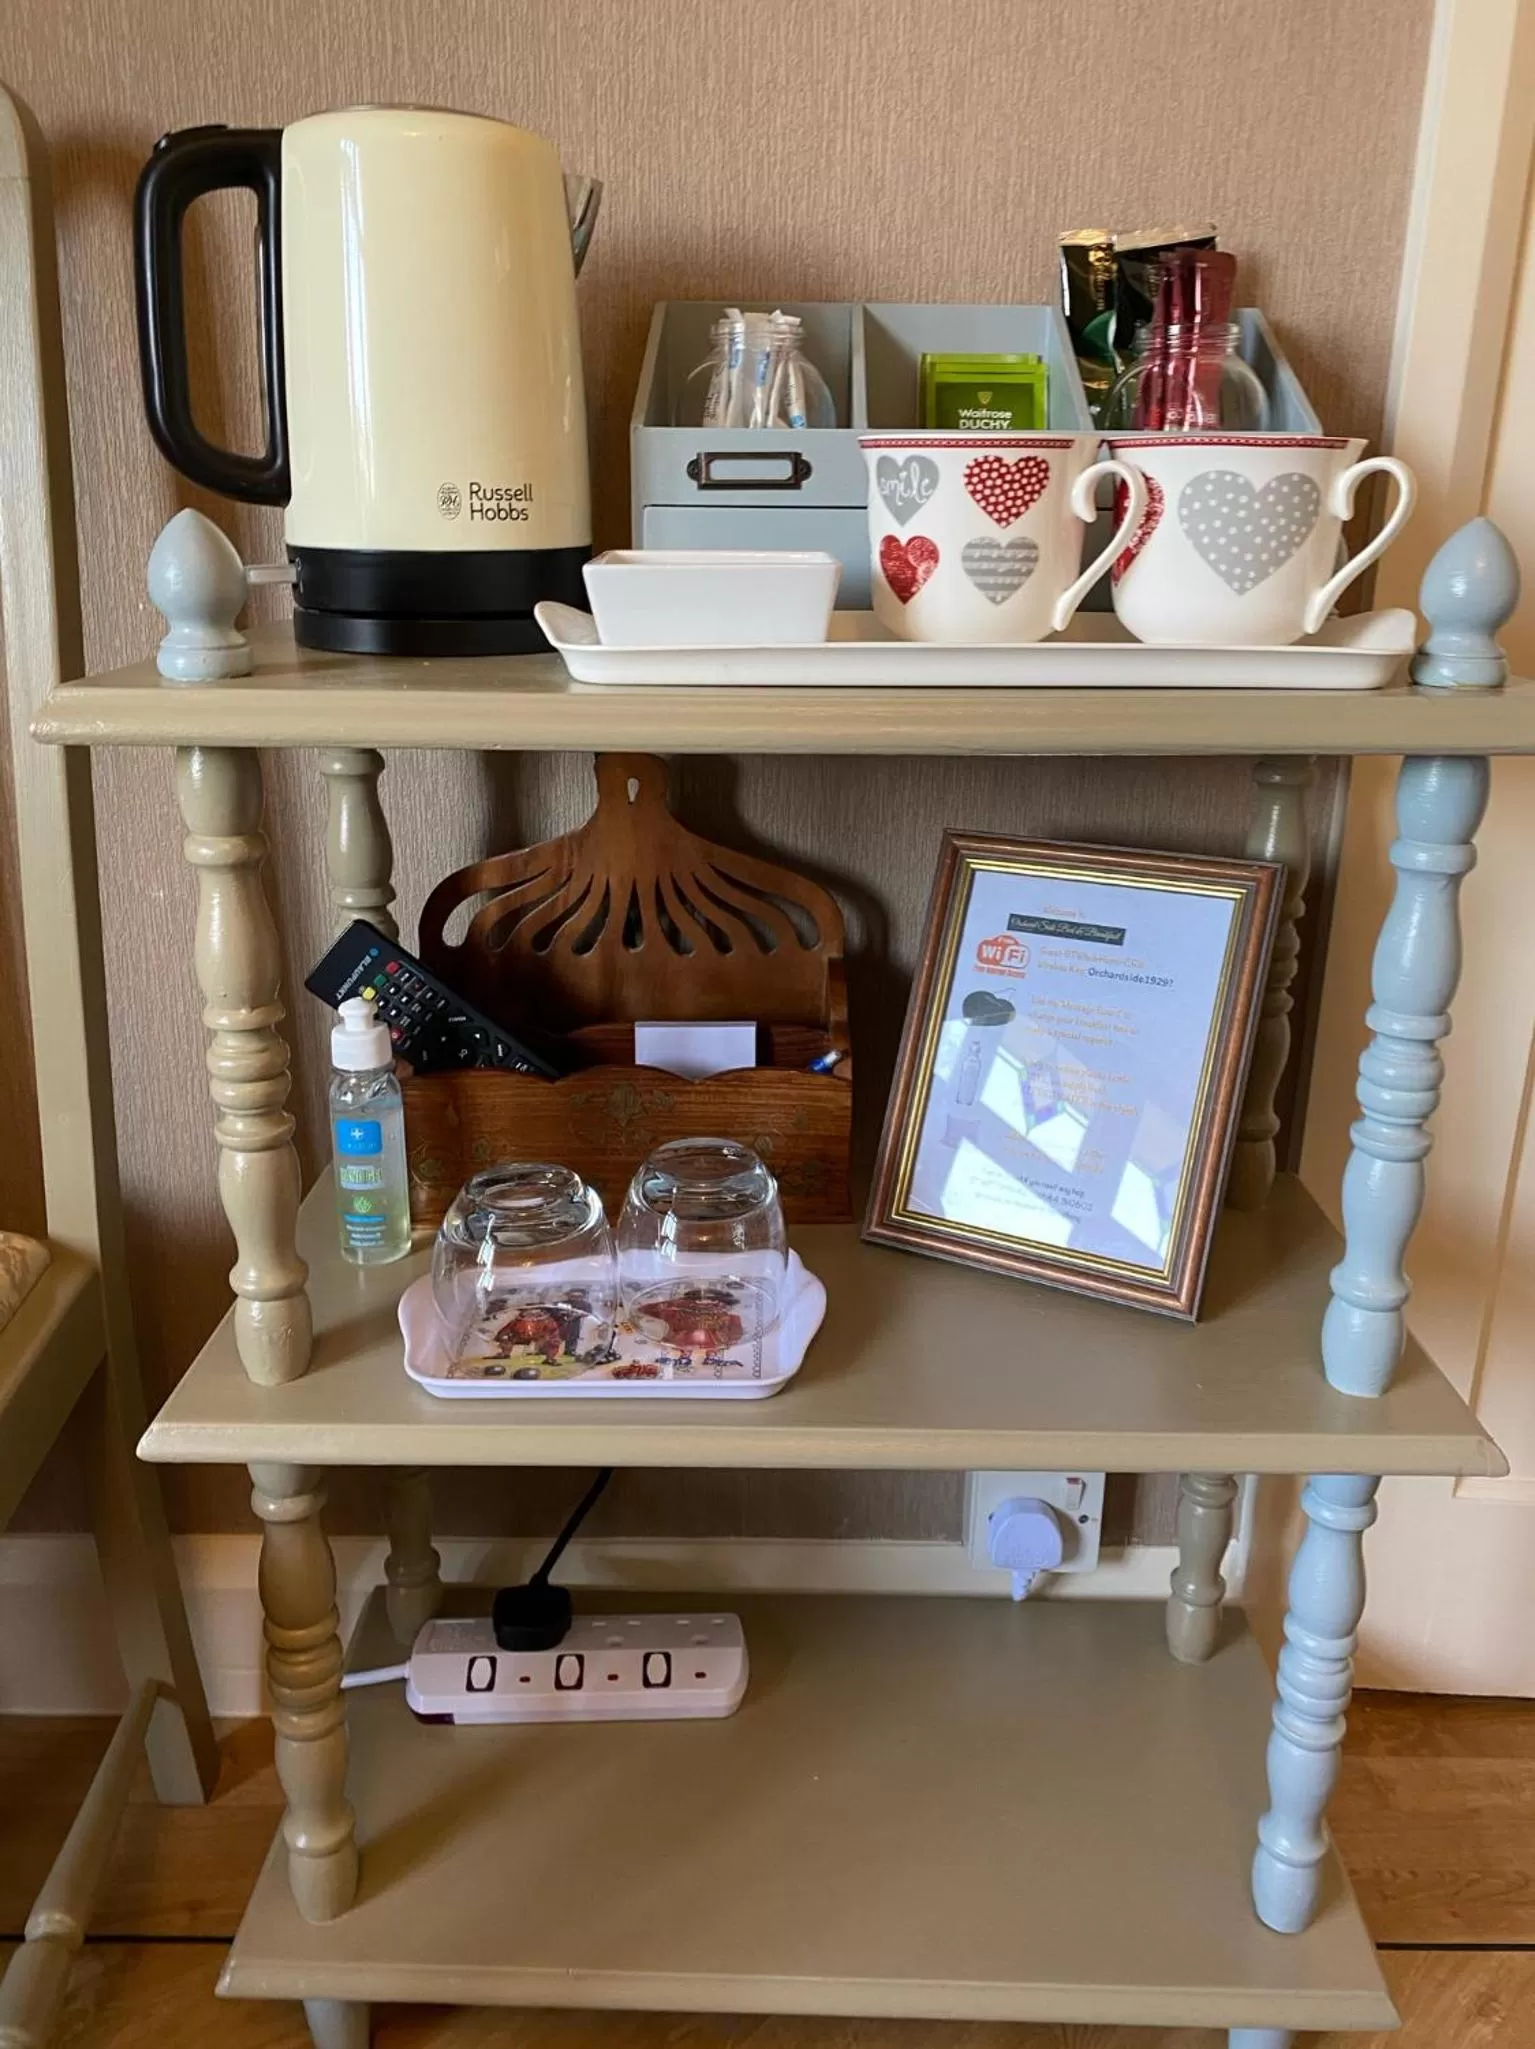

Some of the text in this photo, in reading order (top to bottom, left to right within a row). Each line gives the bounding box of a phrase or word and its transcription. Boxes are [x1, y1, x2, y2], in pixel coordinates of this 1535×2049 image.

[957, 408, 1012, 419] Waitrose
[469, 482, 533, 502] Russell
[470, 502, 530, 521] Hobbs
